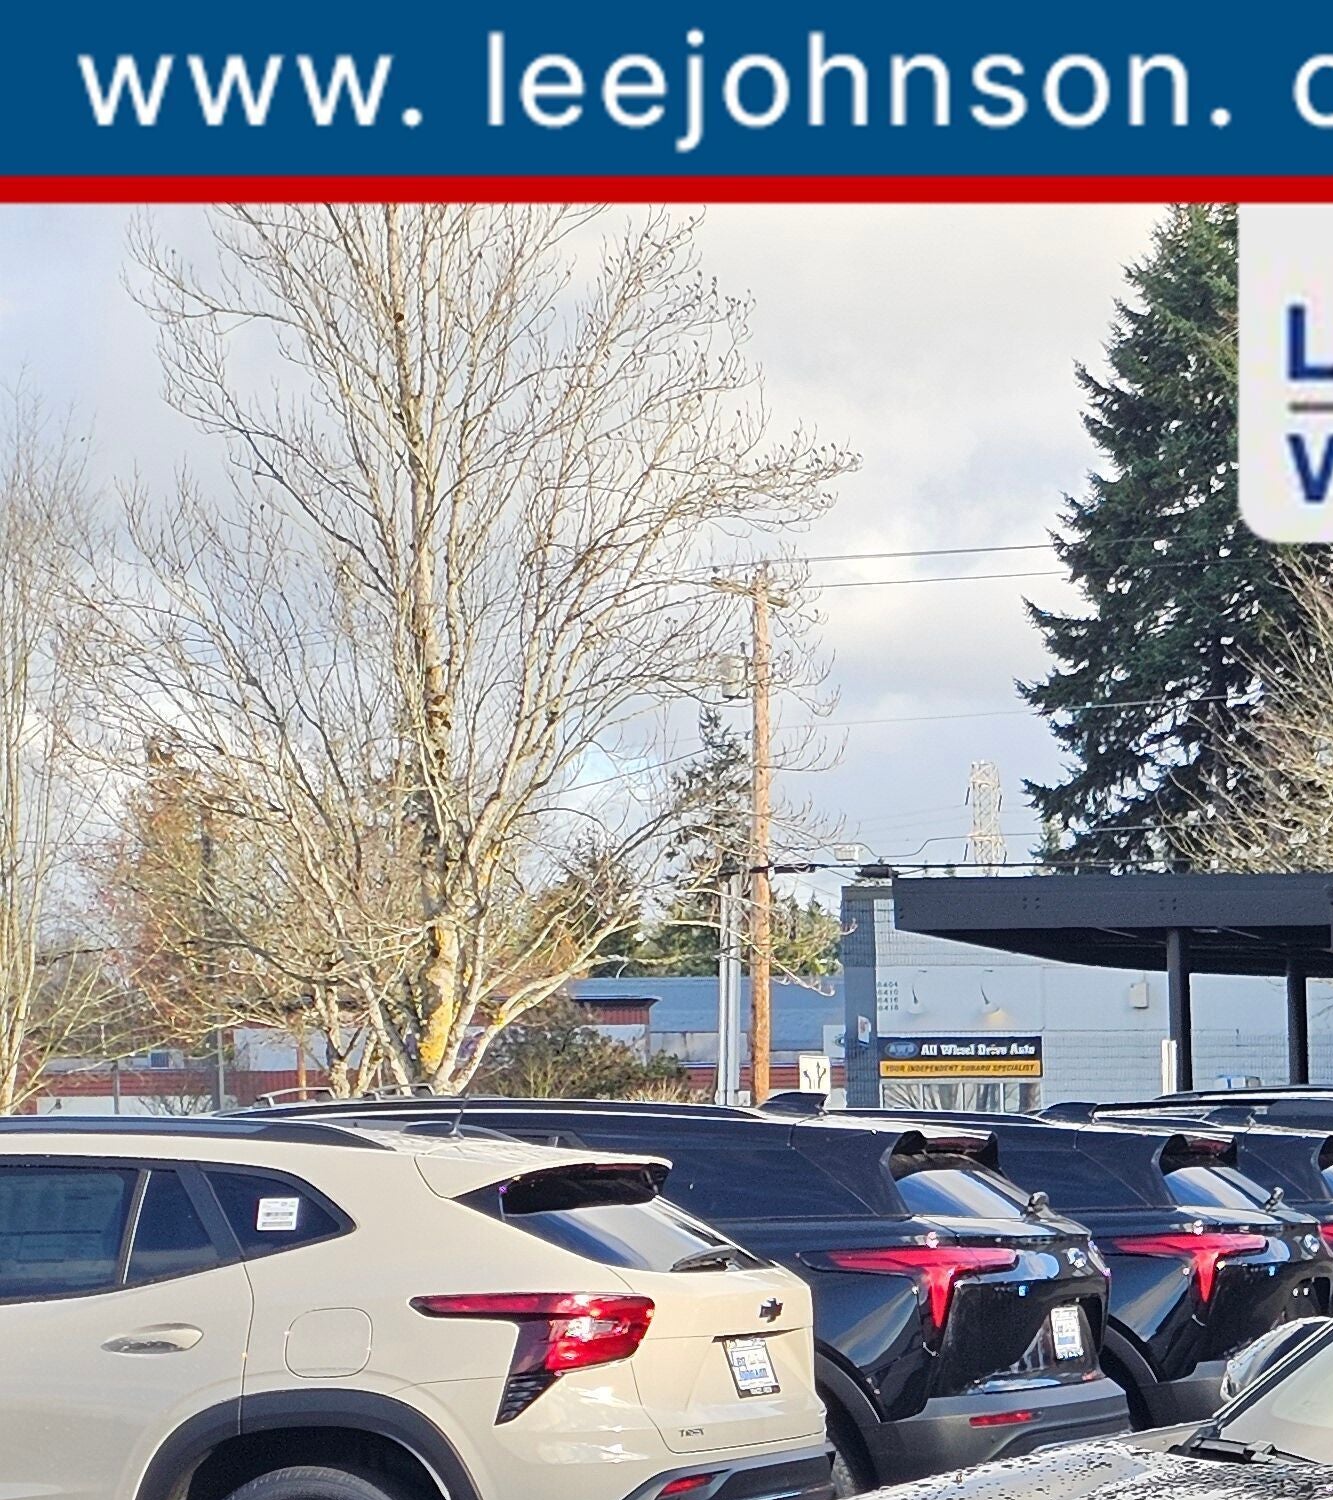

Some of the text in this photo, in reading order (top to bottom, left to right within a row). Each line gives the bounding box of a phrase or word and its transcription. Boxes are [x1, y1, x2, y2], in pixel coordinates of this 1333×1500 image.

[921, 1044, 938, 1056] All
[940, 1043, 975, 1056] Wheel
[977, 1043, 1007, 1056] Drive
[1009, 1042, 1036, 1056] Auto
[885, 1063, 1035, 1073] YOUR INDEPENDENT SUBARU SPECIALIST
